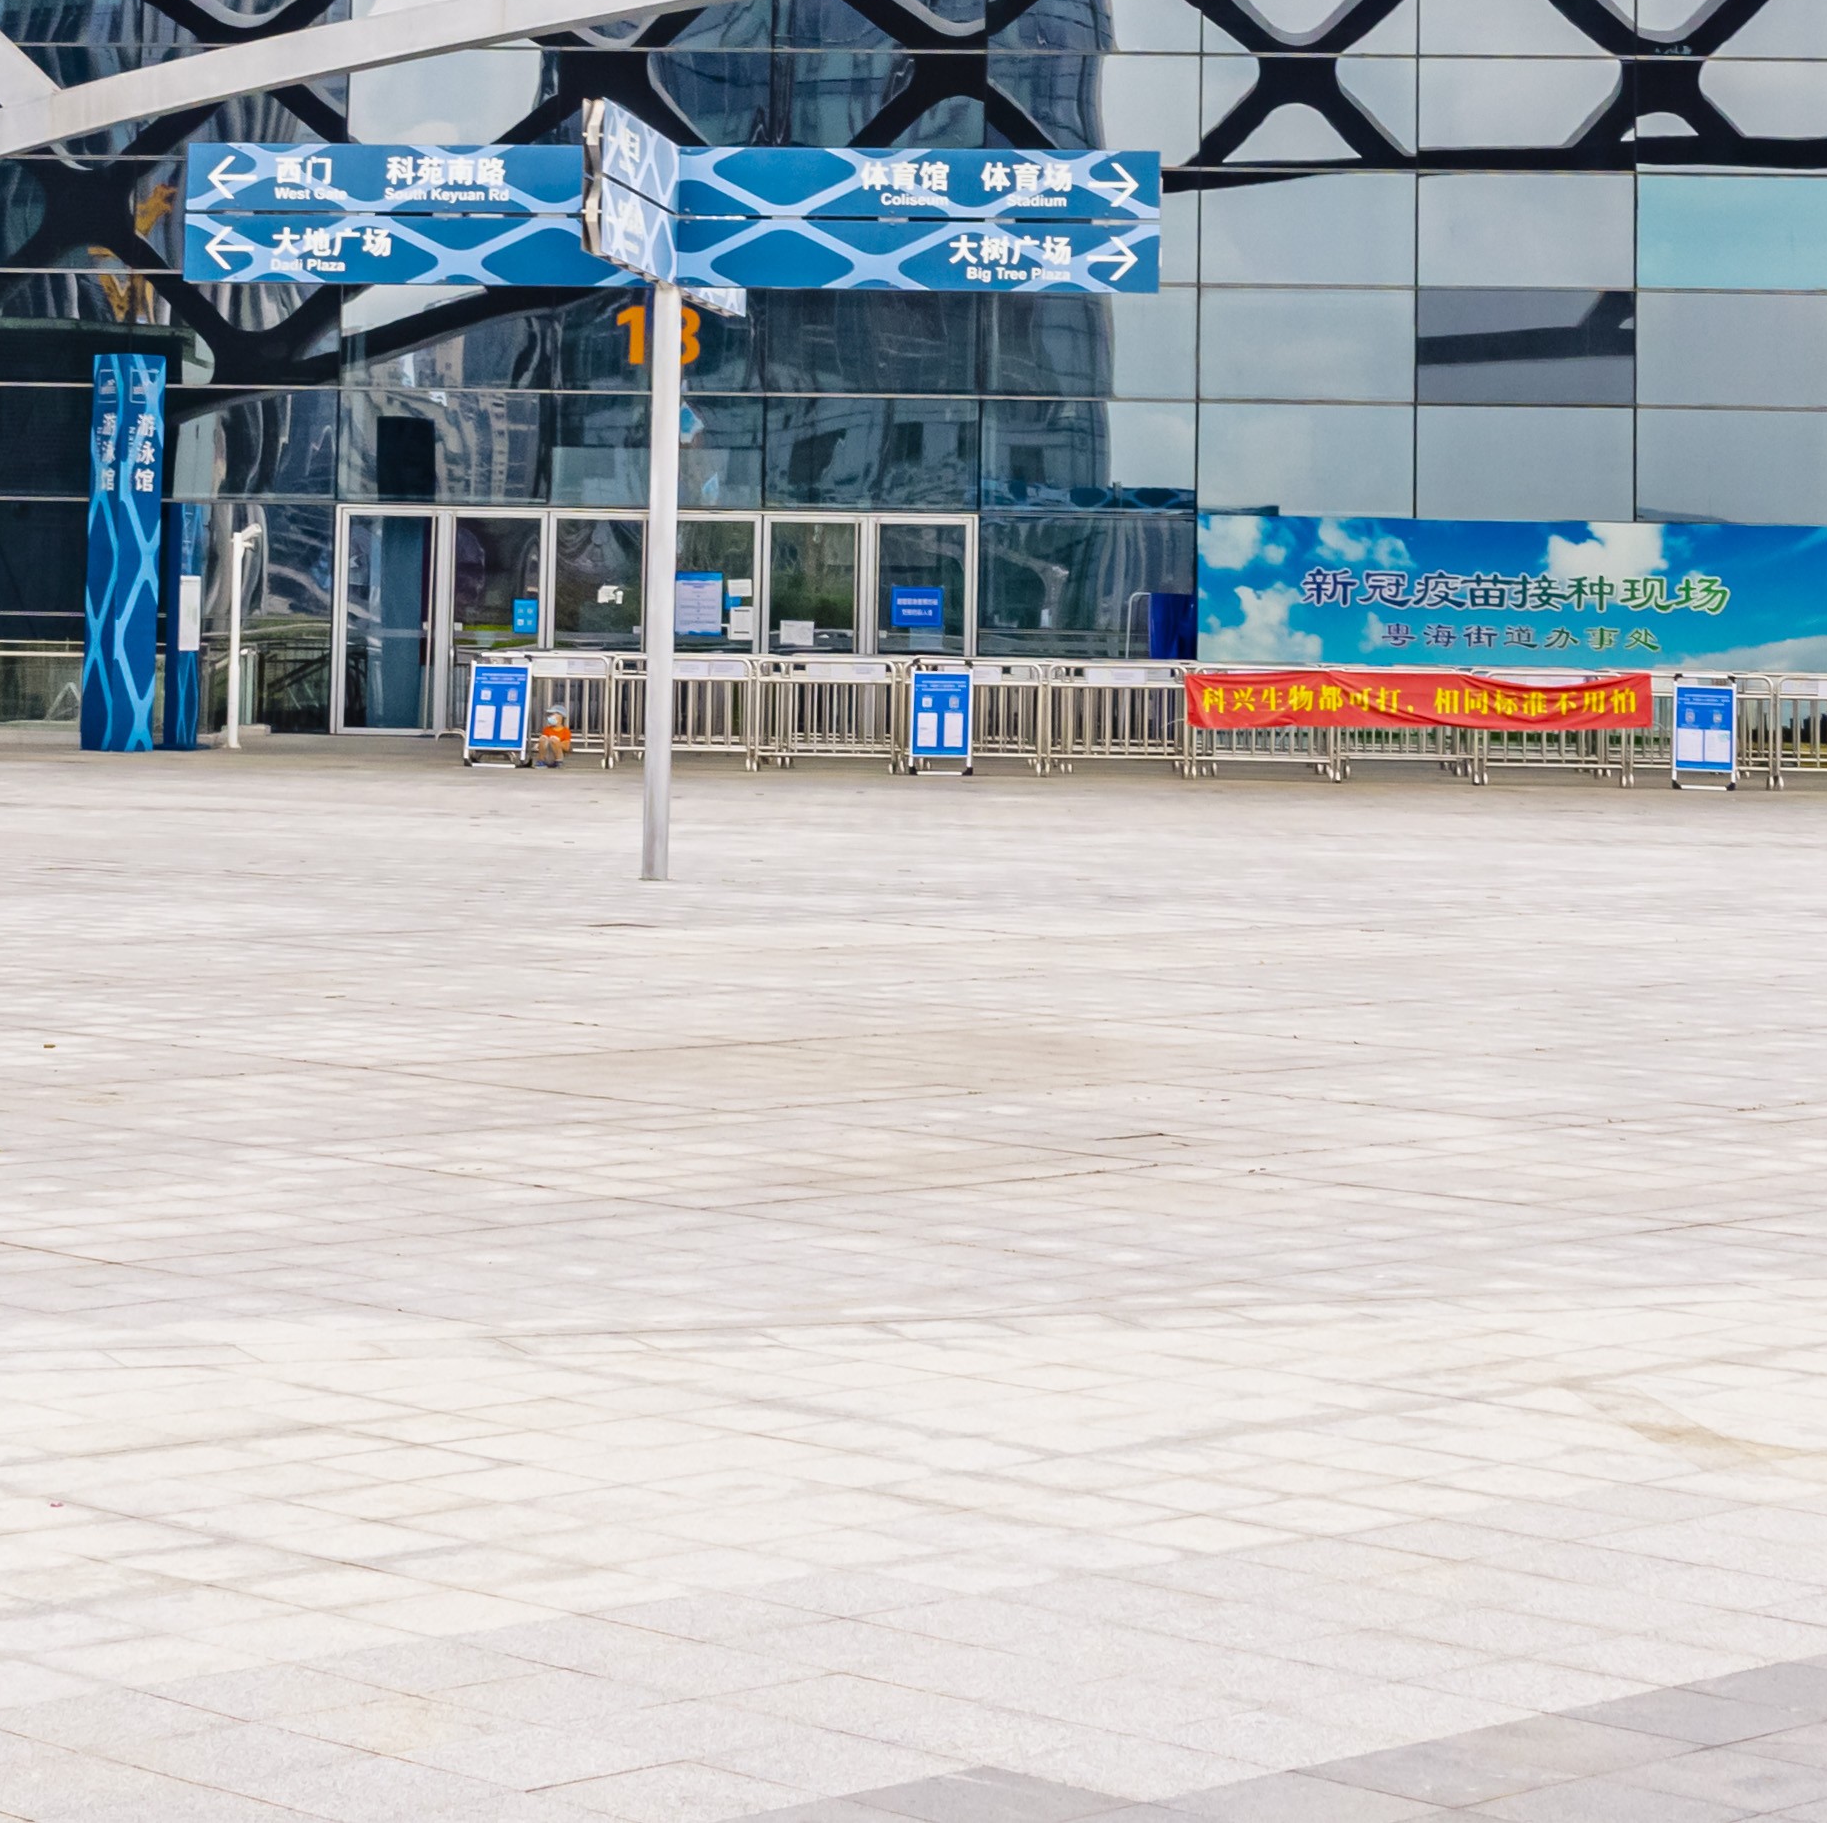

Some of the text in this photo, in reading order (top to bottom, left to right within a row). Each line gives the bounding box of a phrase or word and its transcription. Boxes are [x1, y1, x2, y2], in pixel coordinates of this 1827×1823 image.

[275, 156, 506, 186] 西门 科苑南路
[860, 161, 1073, 192] 体育馆 体育场
[274, 187, 510, 204] West Gate South Keyuan Rd
[880, 193, 1068, 207] Coliseum Stadium
[272, 227, 393, 257] 大地广场
[948, 234, 1073, 265] 大树广场
[270, 258, 346, 272] Dadi Plaza
[966, 266, 1071, 283] Big Tree Plaza
[134, 413, 156, 493] 游泳馆
[1299, 567, 1732, 615] 新冠疫苗接种现场
[1381, 622, 1662, 652] 粤海街道办事处
